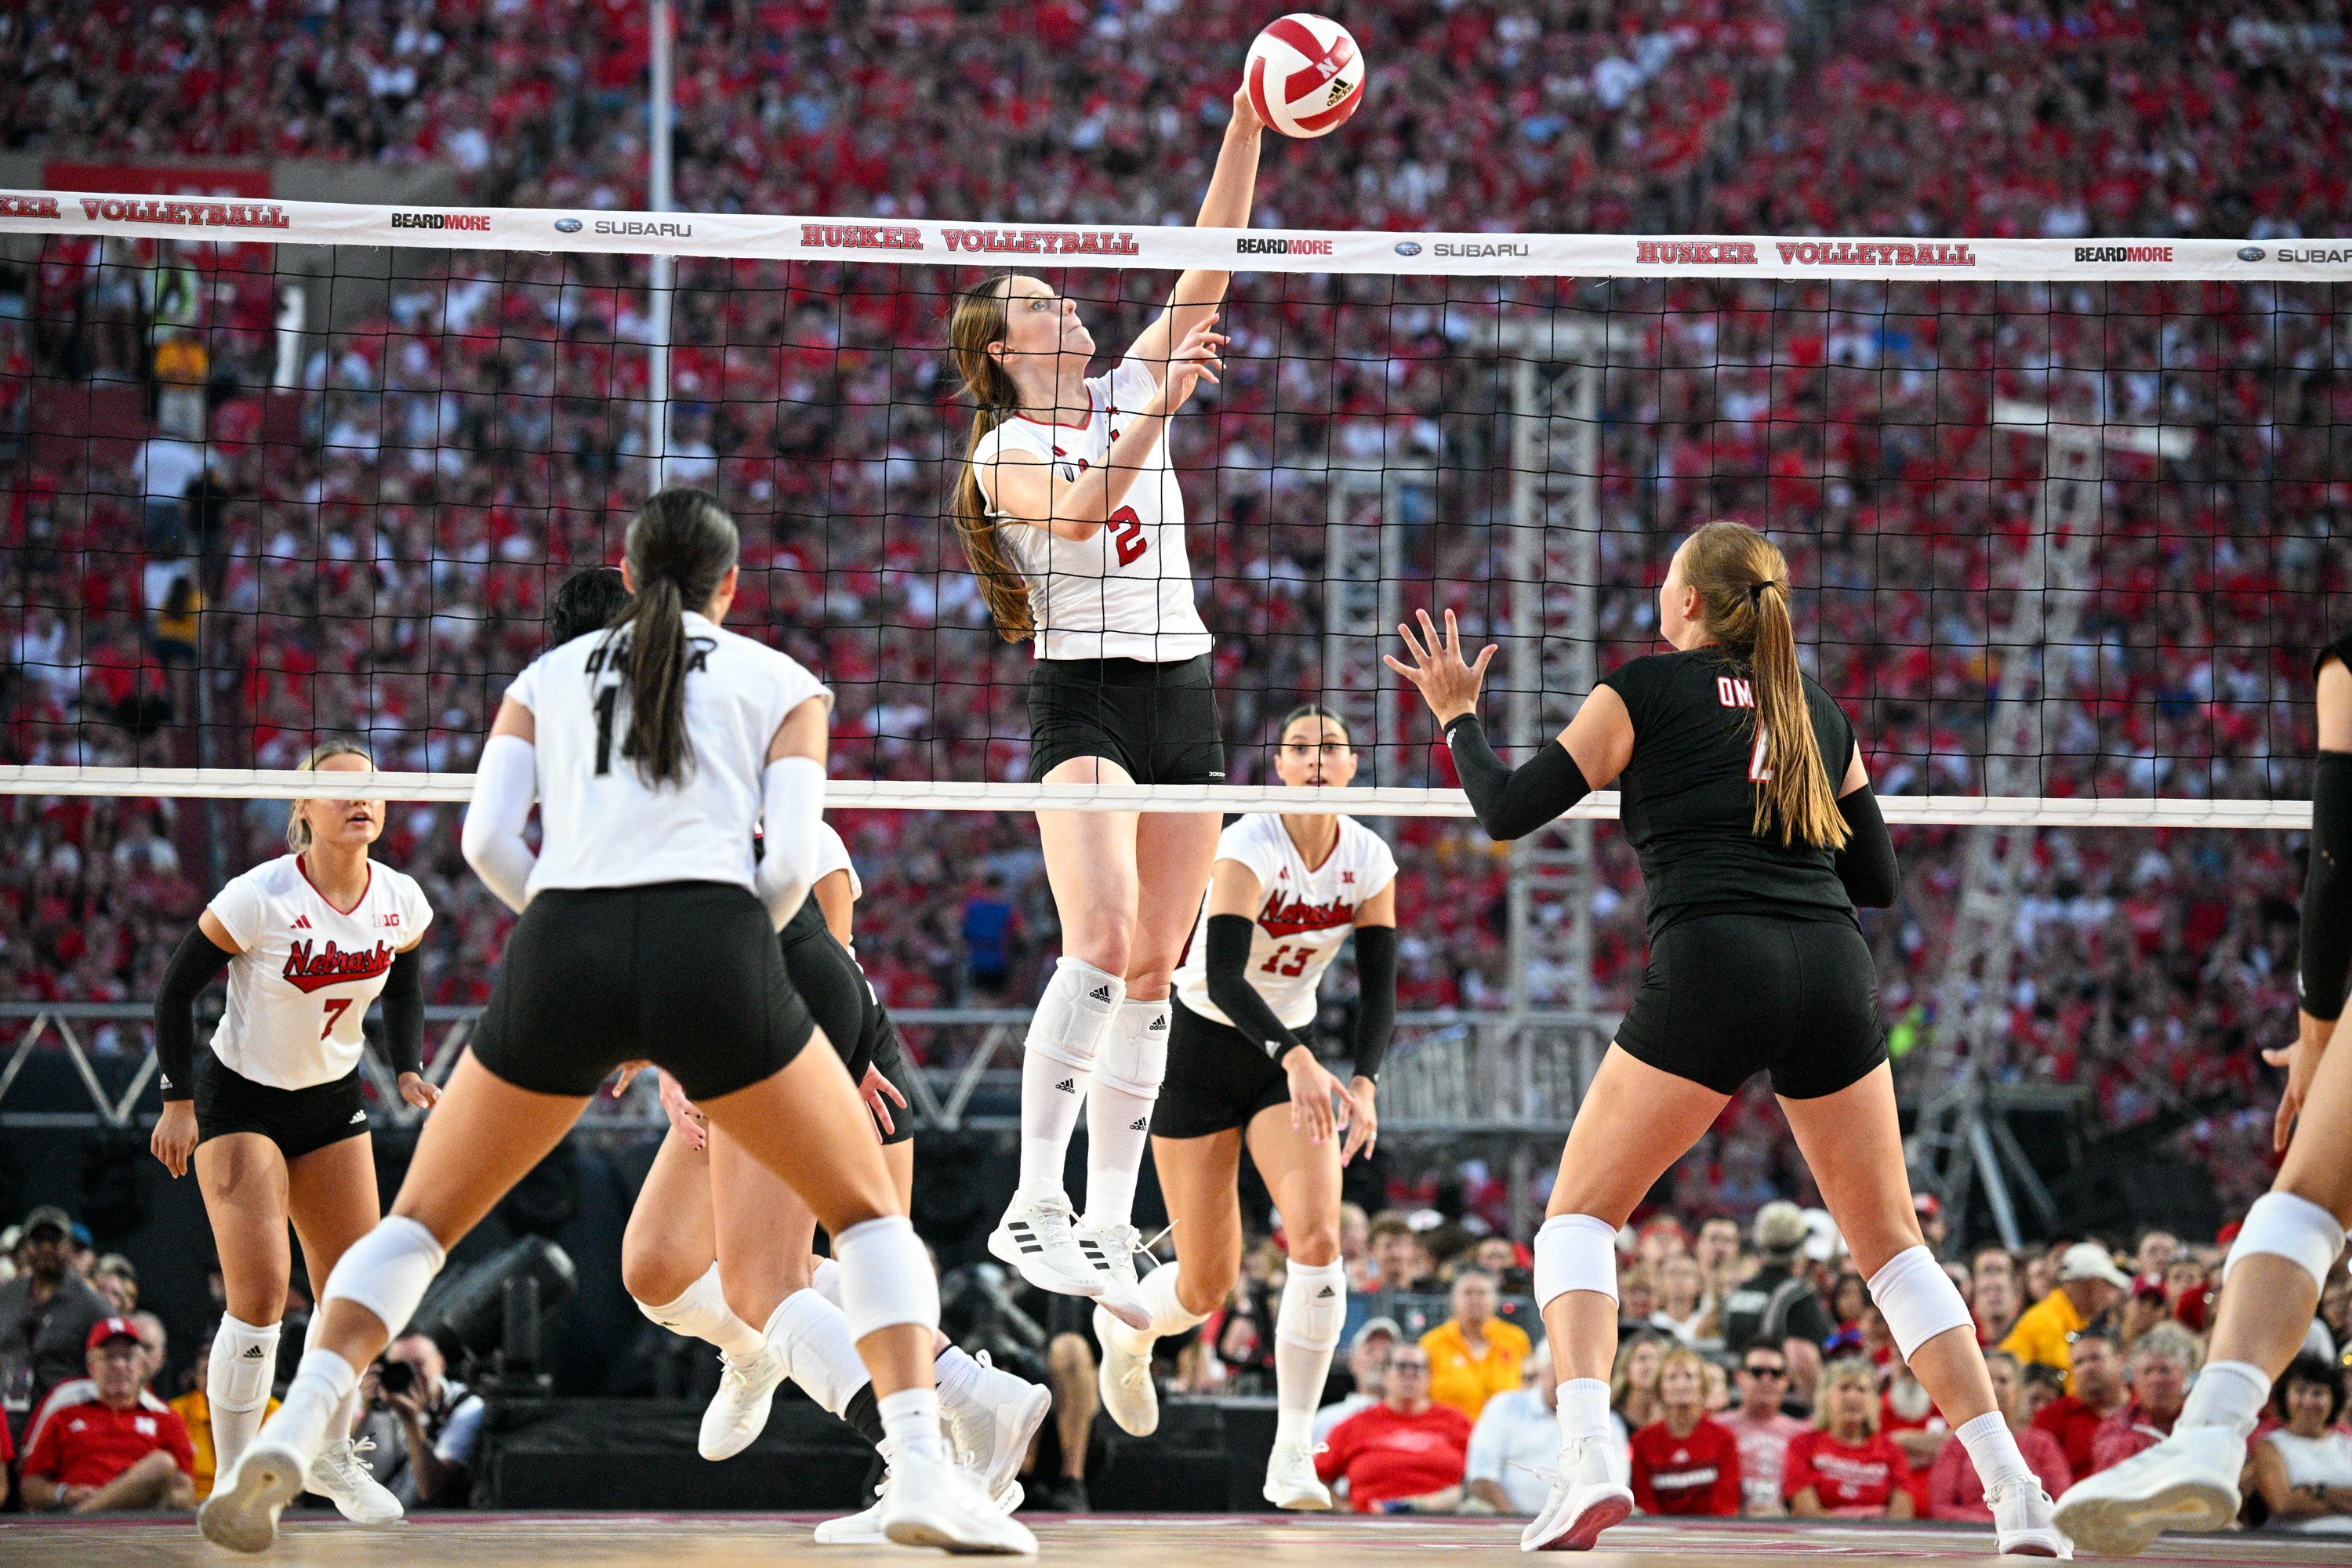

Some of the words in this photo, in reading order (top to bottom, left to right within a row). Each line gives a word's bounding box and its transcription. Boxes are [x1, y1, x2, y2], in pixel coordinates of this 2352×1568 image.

[1316, 57, 1338, 79] N
[1327, 82, 1354, 107] adidas
[80, 198, 289, 228] VOLLEYBALL
[392, 212, 491, 231] BEARDMORE
[594, 220, 692, 237] SUBARU
[801, 224, 924, 250] HUSKER
[941, 229, 1139, 255] VOLLEYBALL
[1236, 238, 1333, 256] BEARDMORE
[1434, 243, 1529, 257] SUBARU
[1637, 241, 1758, 264] HUSKER
[1776, 242, 1975, 267] VOLLEYBALL
[2074, 246, 2173, 263] BEARDMORE
[1106, 505, 1148, 568] 2
[593, 684, 618, 776] 1
[1089, 992, 1111, 1004] adidas
[321, 999, 354, 1041] 7
[1055, 1083, 1076, 1094] adidas
